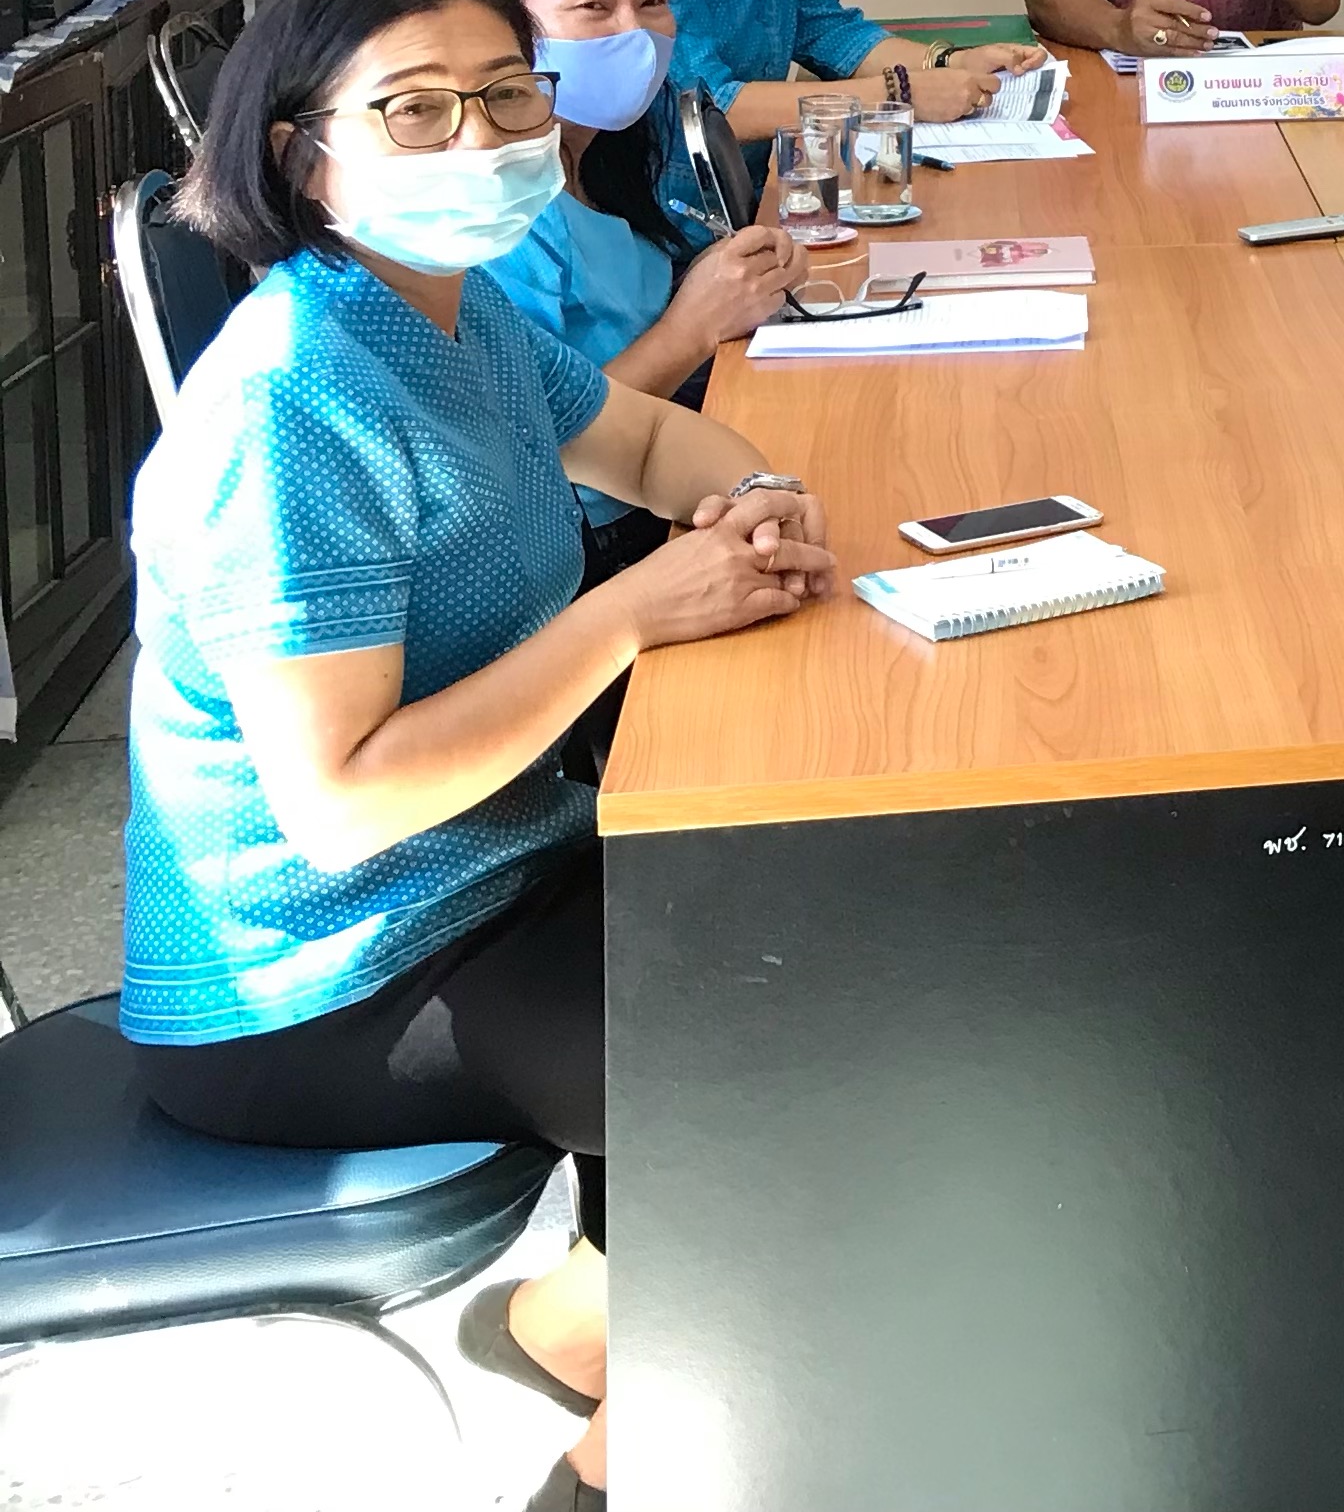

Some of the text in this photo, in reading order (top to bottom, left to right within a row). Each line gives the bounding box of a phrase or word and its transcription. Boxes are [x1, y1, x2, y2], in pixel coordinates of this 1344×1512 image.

[1203, 77, 1263, 90] นายพนม
[1263, 825, 1307, 856] พช.
